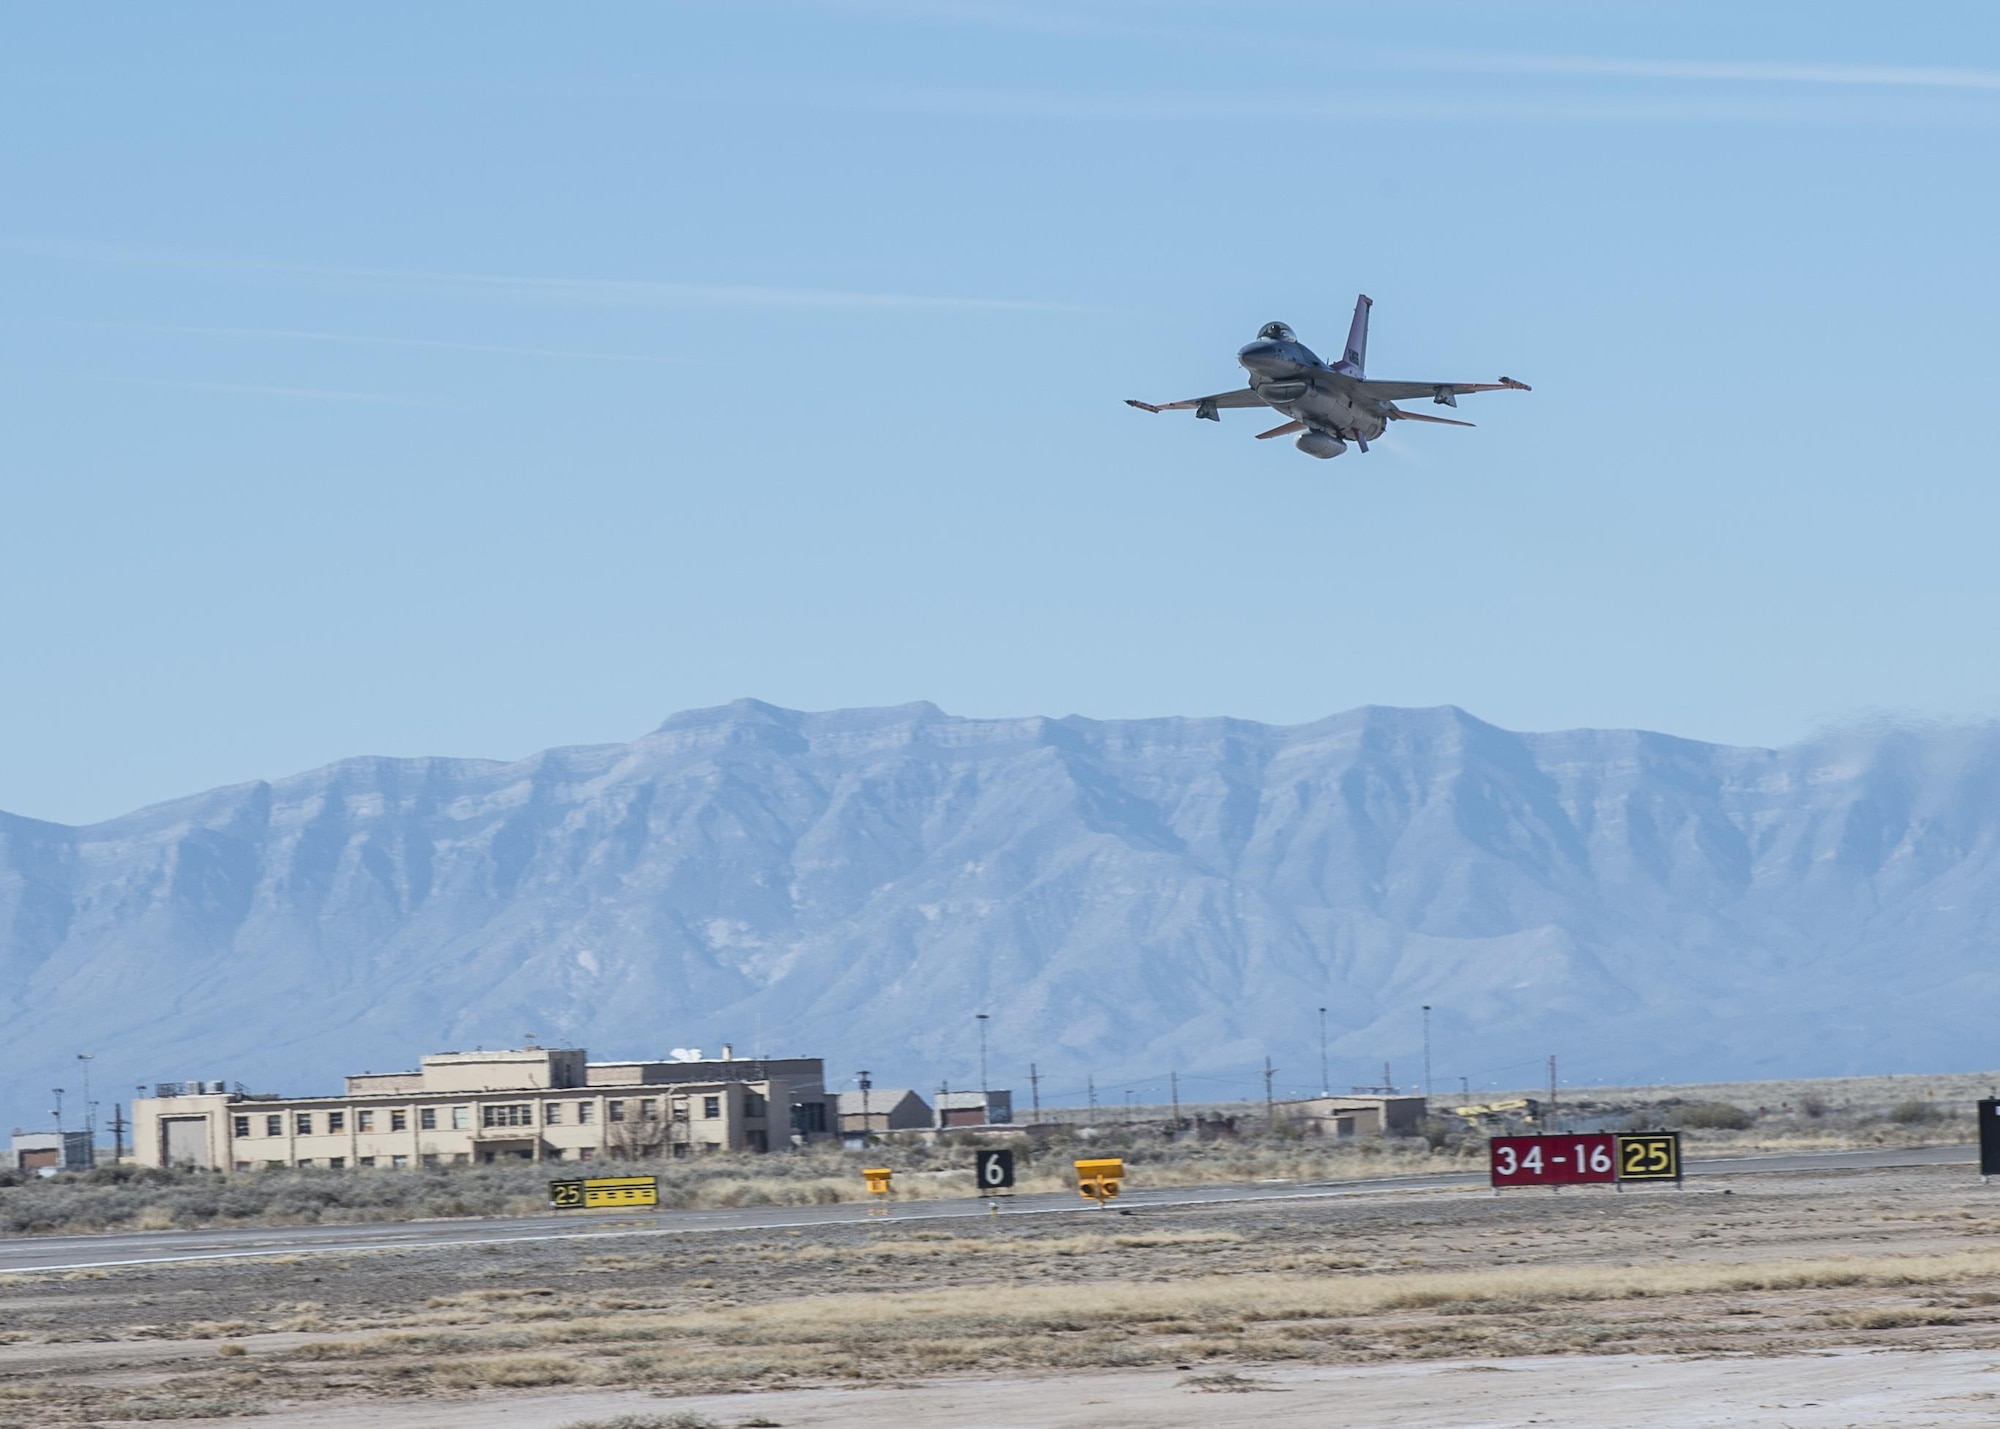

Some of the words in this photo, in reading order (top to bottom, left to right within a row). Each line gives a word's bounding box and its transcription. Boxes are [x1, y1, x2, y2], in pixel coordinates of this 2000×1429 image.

[985, 1153, 1004, 1185] 6
[1496, 1144, 1612, 1175] 34-16
[1625, 1142, 1669, 1172] 25
[554, 1185, 580, 1204] 25
